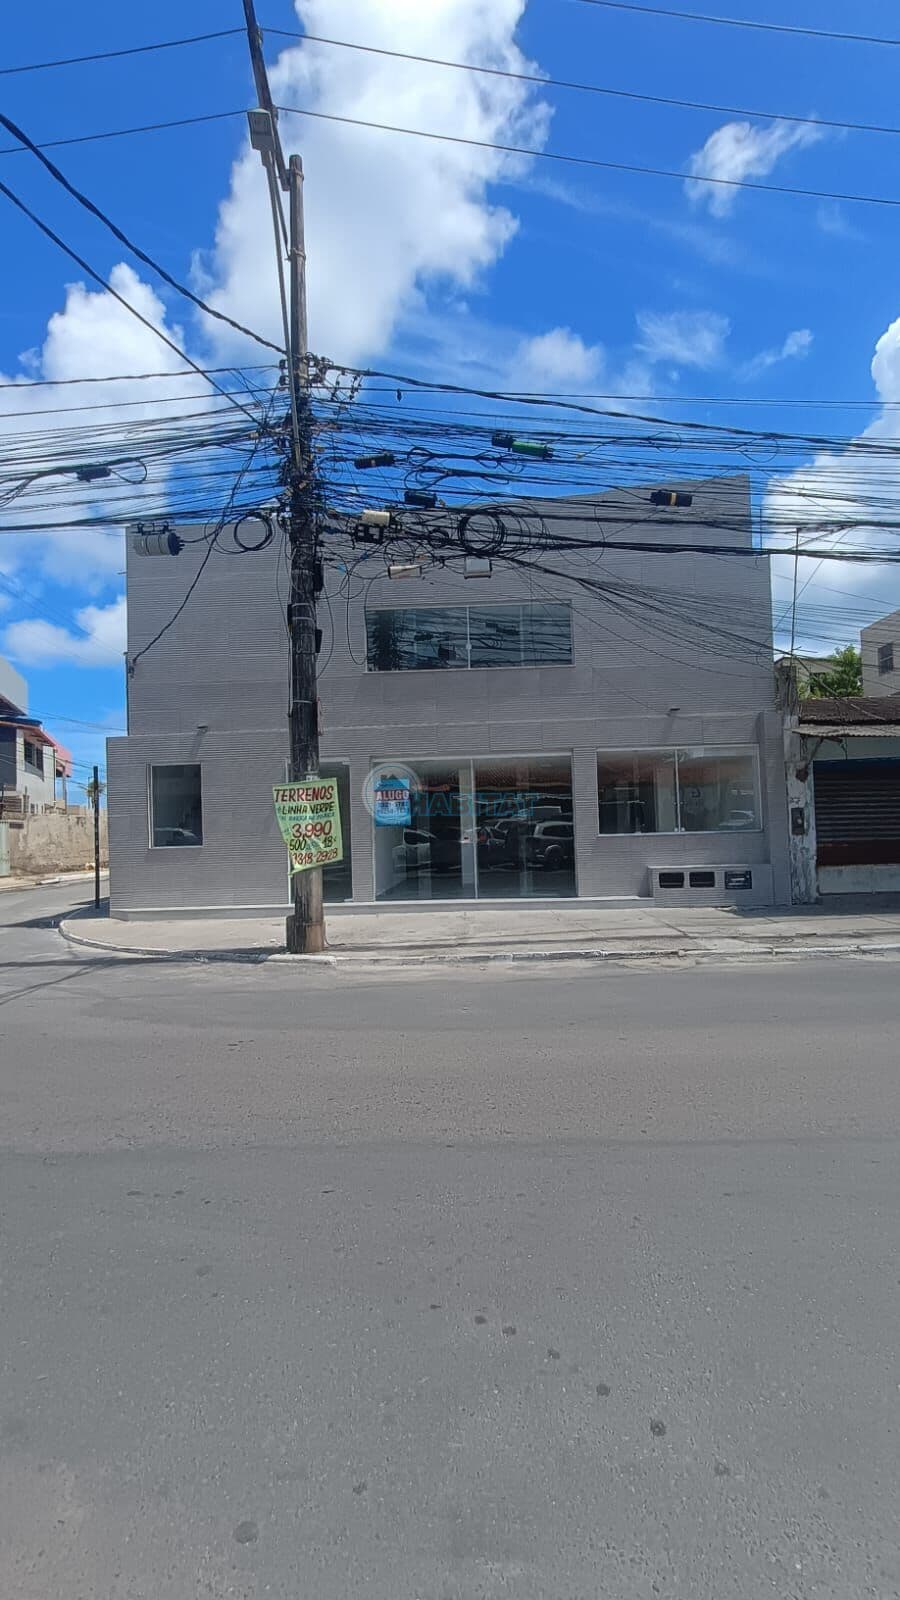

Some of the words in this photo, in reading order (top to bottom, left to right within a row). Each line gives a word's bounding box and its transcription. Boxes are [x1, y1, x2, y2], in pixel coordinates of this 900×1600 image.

[273, 785, 334, 803] TERRENOS
[376, 790, 410, 801] ALUGO
[282, 803, 308, 815] LINHA
[309, 801, 335, 815] VERDE
[289, 839, 307, 851] 500
